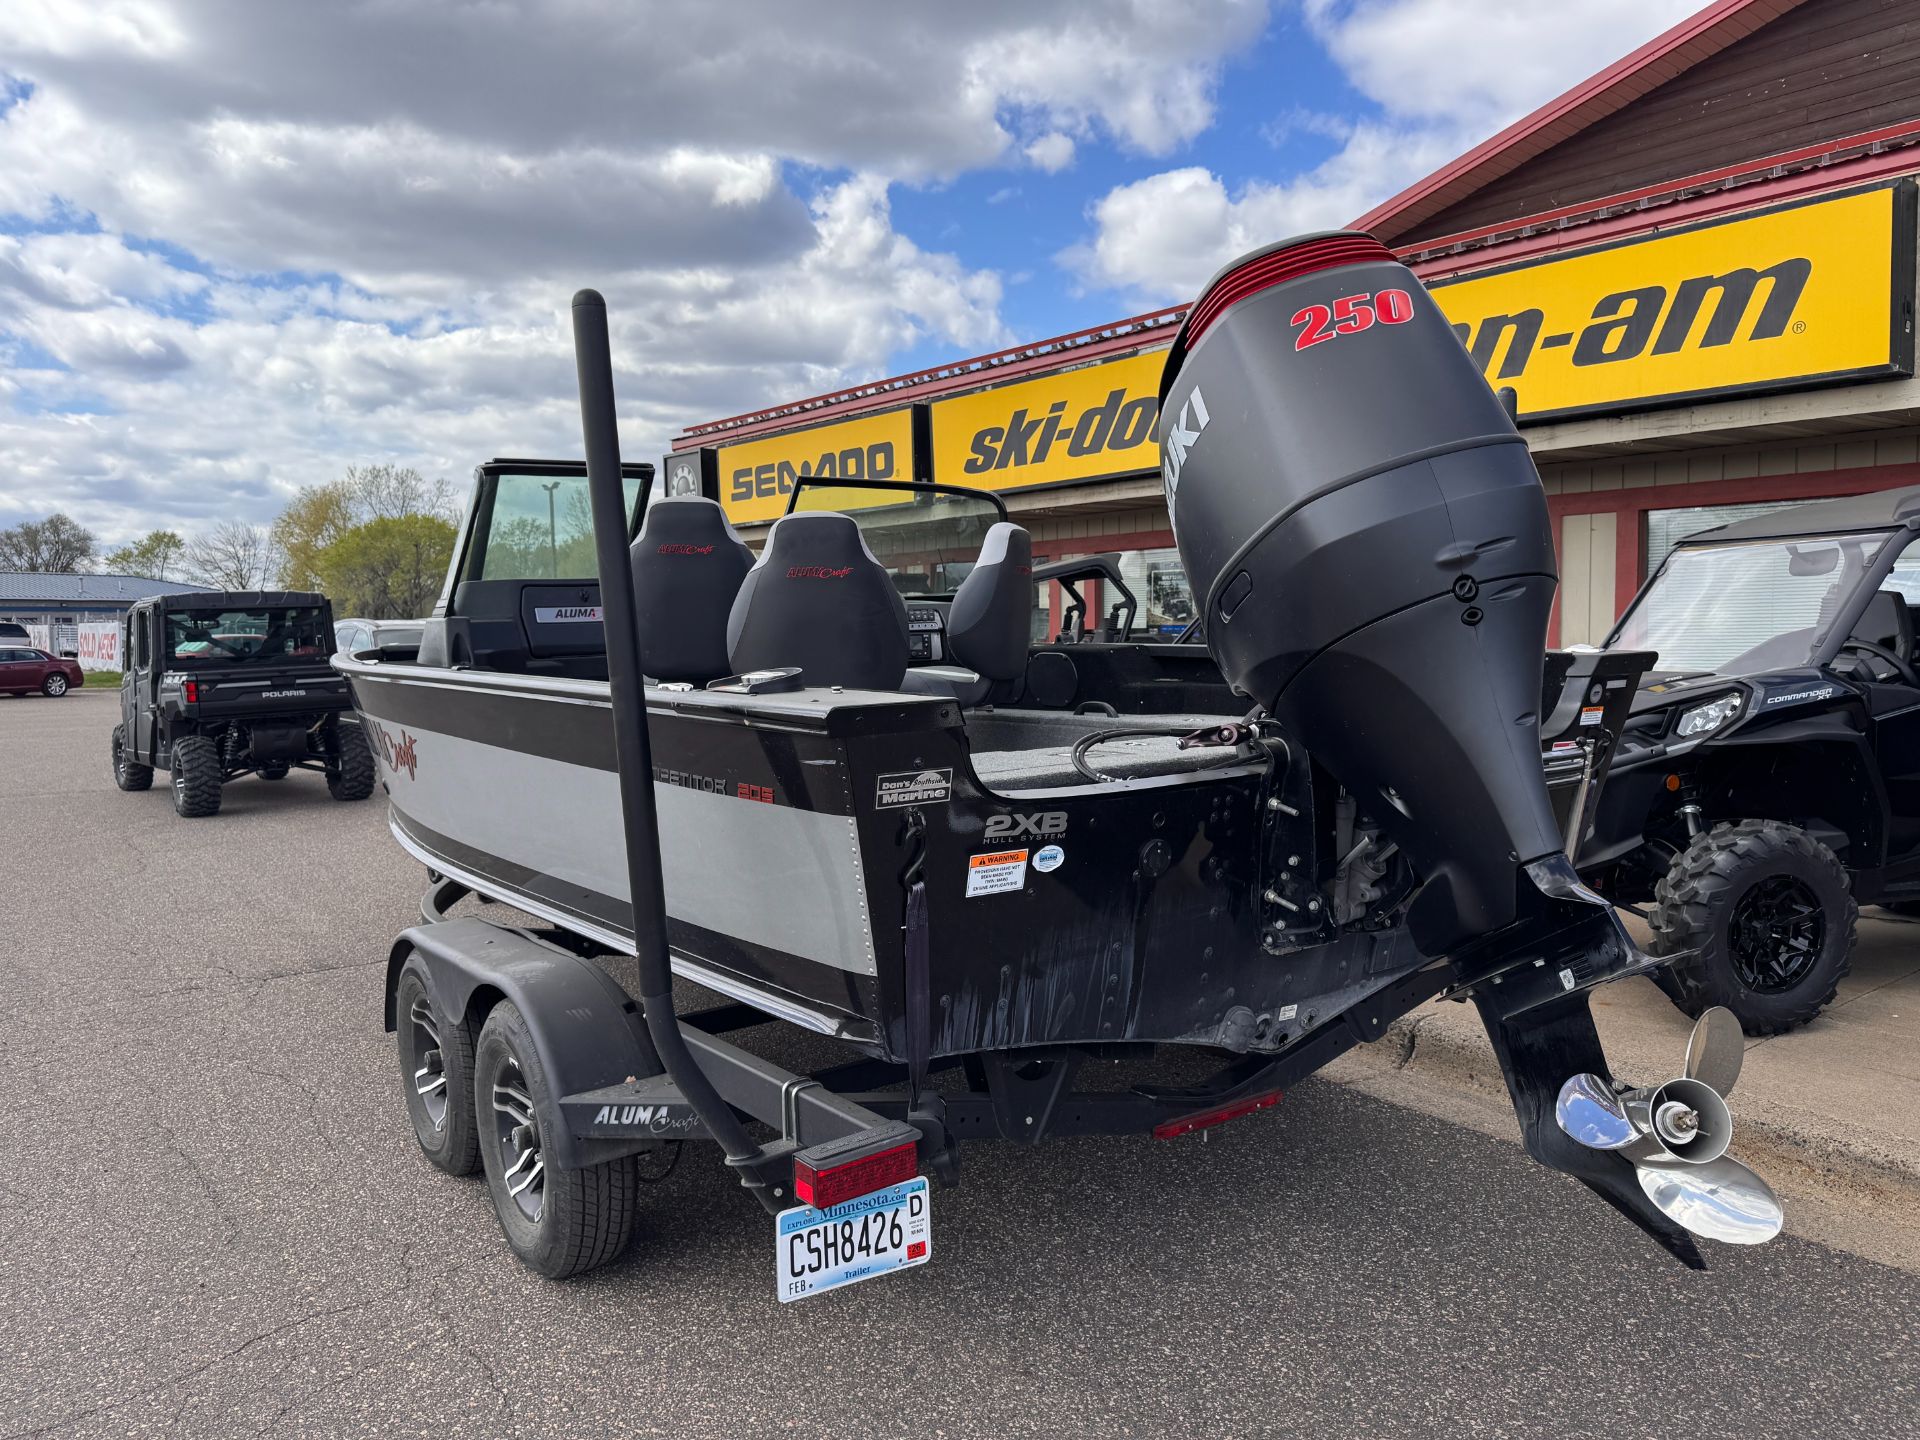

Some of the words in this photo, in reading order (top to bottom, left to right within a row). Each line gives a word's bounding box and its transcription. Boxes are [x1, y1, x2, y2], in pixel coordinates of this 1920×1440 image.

[1290, 289, 1415, 351] 250
[1452, 257, 1812, 380] n-am
[963, 388, 1160, 474] ski-do
[262, 690, 306, 698] POLARIS
[1767, 688, 1833, 704] COMMANDER
[882, 780, 911, 790] Dan's
[737, 783, 775, 804] 205
[882, 789, 946, 804] Marine
[984, 811, 1068, 838] 2XB
[983, 837, 1013, 845] HULL
[1020, 833, 1066, 842] SYSTEM
[987, 854, 1020, 863] WARNING
[909, 1194, 923, 1218] D
[787, 1216, 817, 1230] EXPLORE
[789, 1207, 903, 1278] CSH8426
[911, 1243, 922, 1253] 26
[844, 1265, 871, 1279] Trailer
[789, 1280, 806, 1296] FEB
